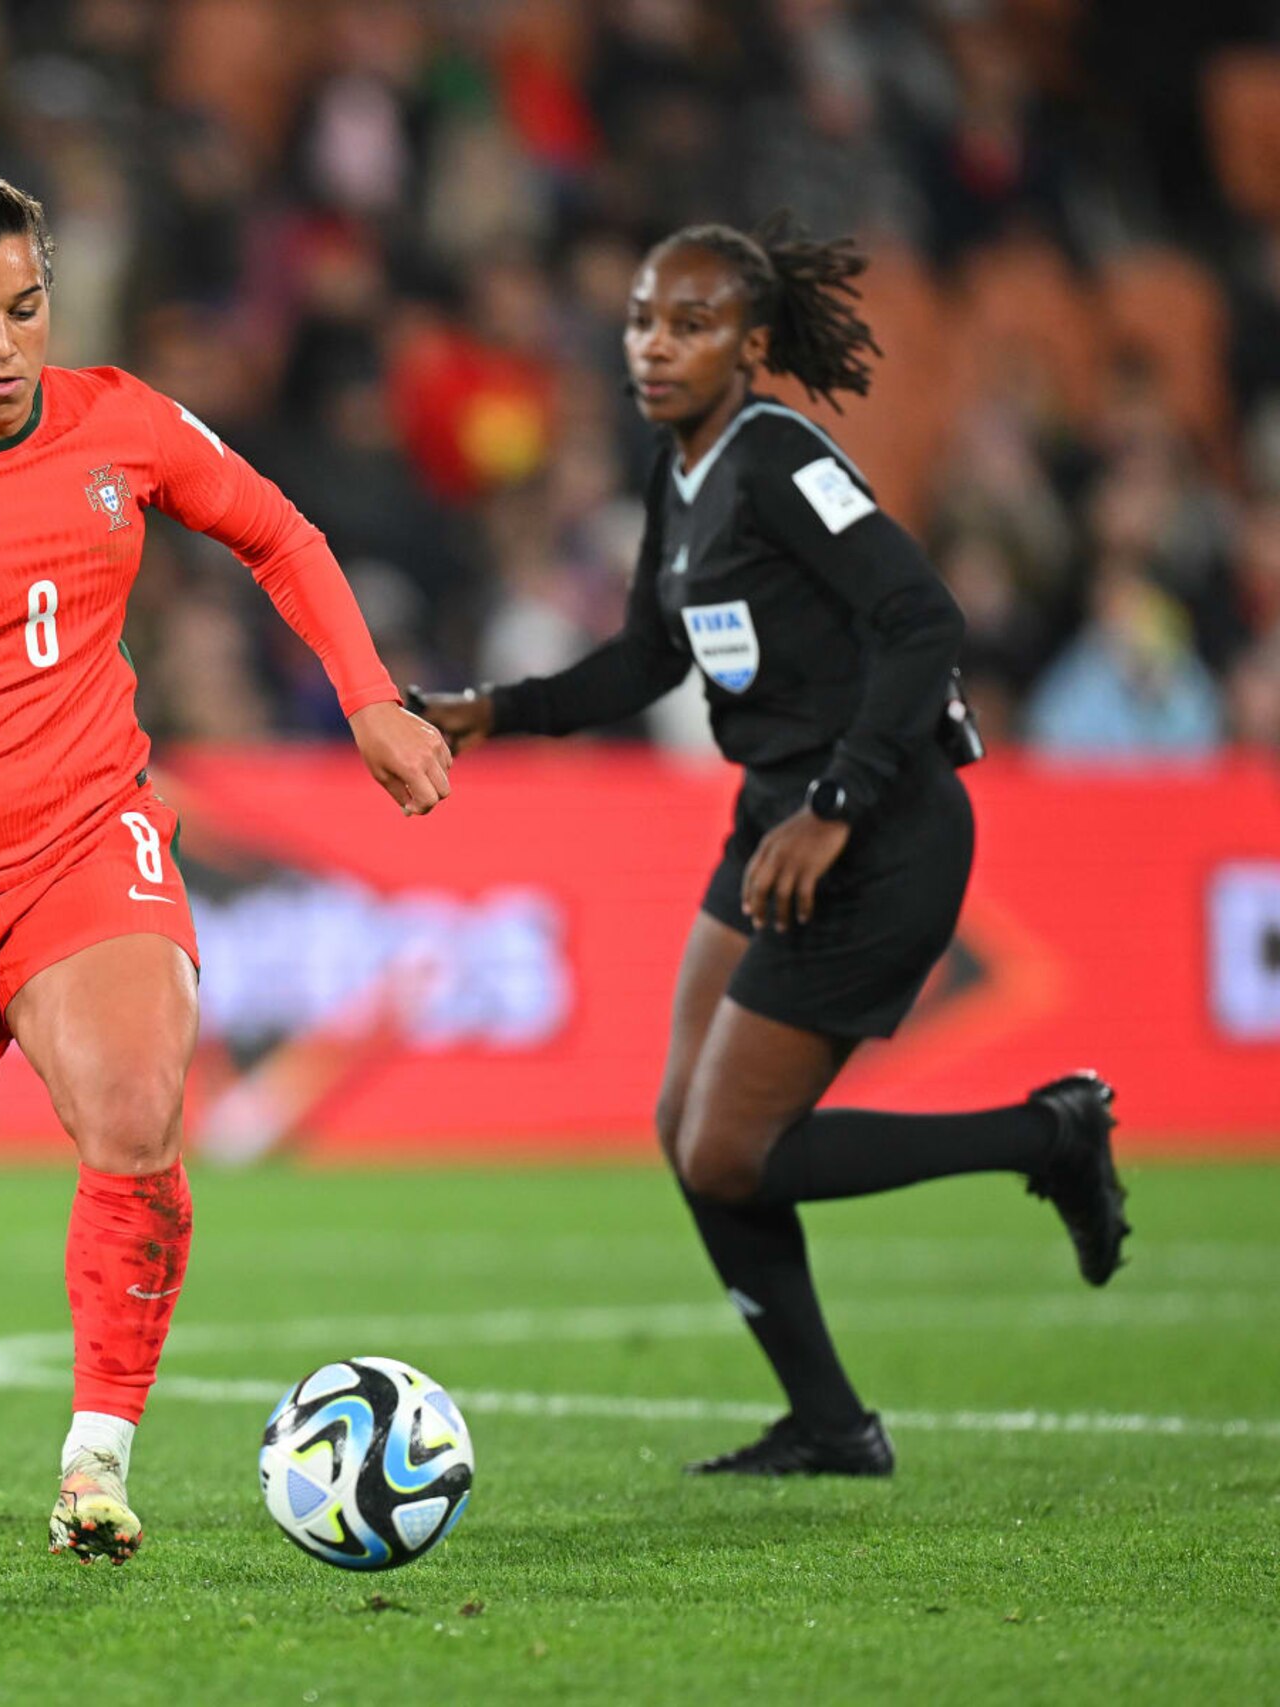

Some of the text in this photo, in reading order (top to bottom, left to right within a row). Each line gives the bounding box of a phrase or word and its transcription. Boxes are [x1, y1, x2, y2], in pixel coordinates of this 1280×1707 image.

[25, 579, 60, 668] 8
[692, 611, 743, 633] FIFA
[120, 811, 163, 884] 8
